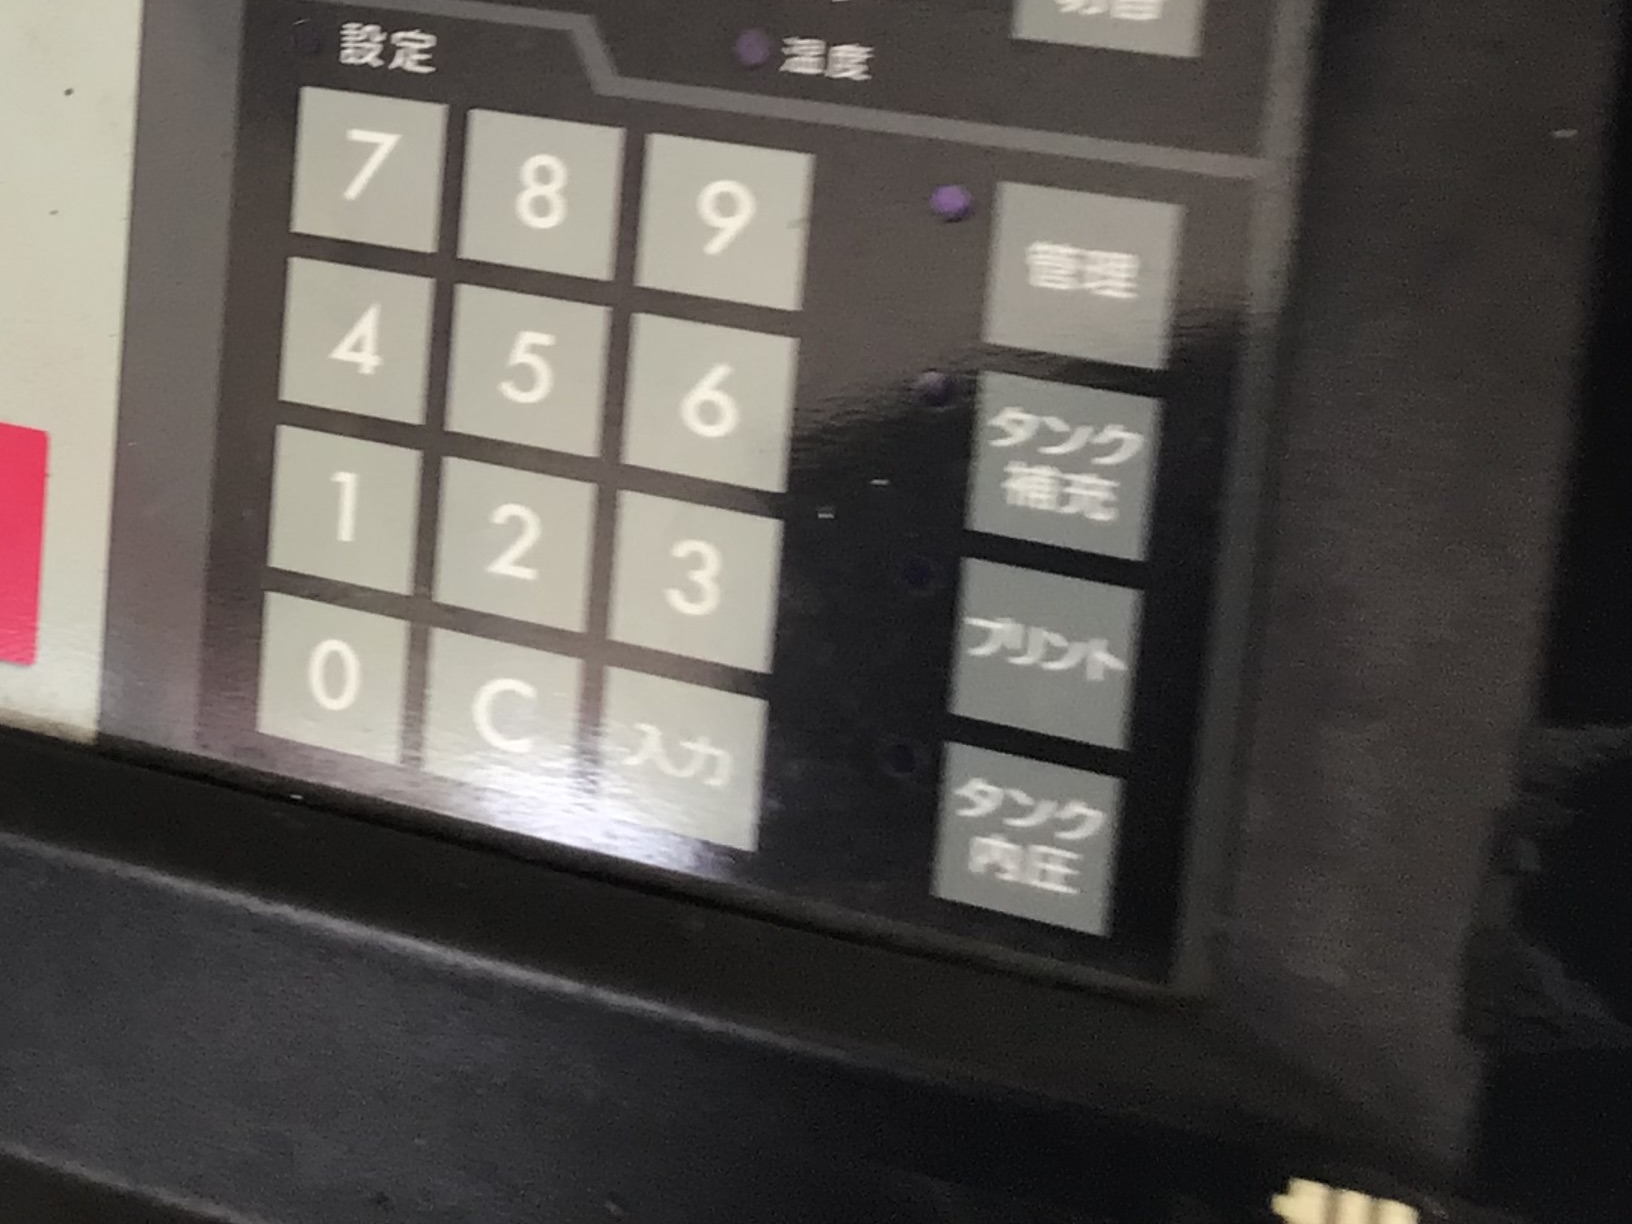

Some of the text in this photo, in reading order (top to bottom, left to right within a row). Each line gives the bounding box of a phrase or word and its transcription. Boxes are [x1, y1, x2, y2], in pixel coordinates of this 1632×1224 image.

[339, 21, 438, 75] 設定
[343, 127, 402, 203] 7
[514, 153, 569, 230] 8
[697, 179, 756, 257] 9
[329, 302, 382, 376] 4
[496, 330, 556, 404] 5
[679, 363, 740, 439] 6
[986, 405, 1145, 467] タンク
[330, 469, 358, 543] 1
[1000, 460, 1121, 525] 補充
[486, 502, 543, 581] 2
[664, 538, 722, 617] 3
[307, 637, 361, 712] 0
[965, 614, 1131, 683] プリント
[471, 677, 536, 753] C
[624, 722, 733, 791] 入力
[953, 777, 1107, 841] タンク
[967, 831, 1083, 897] 内圧
